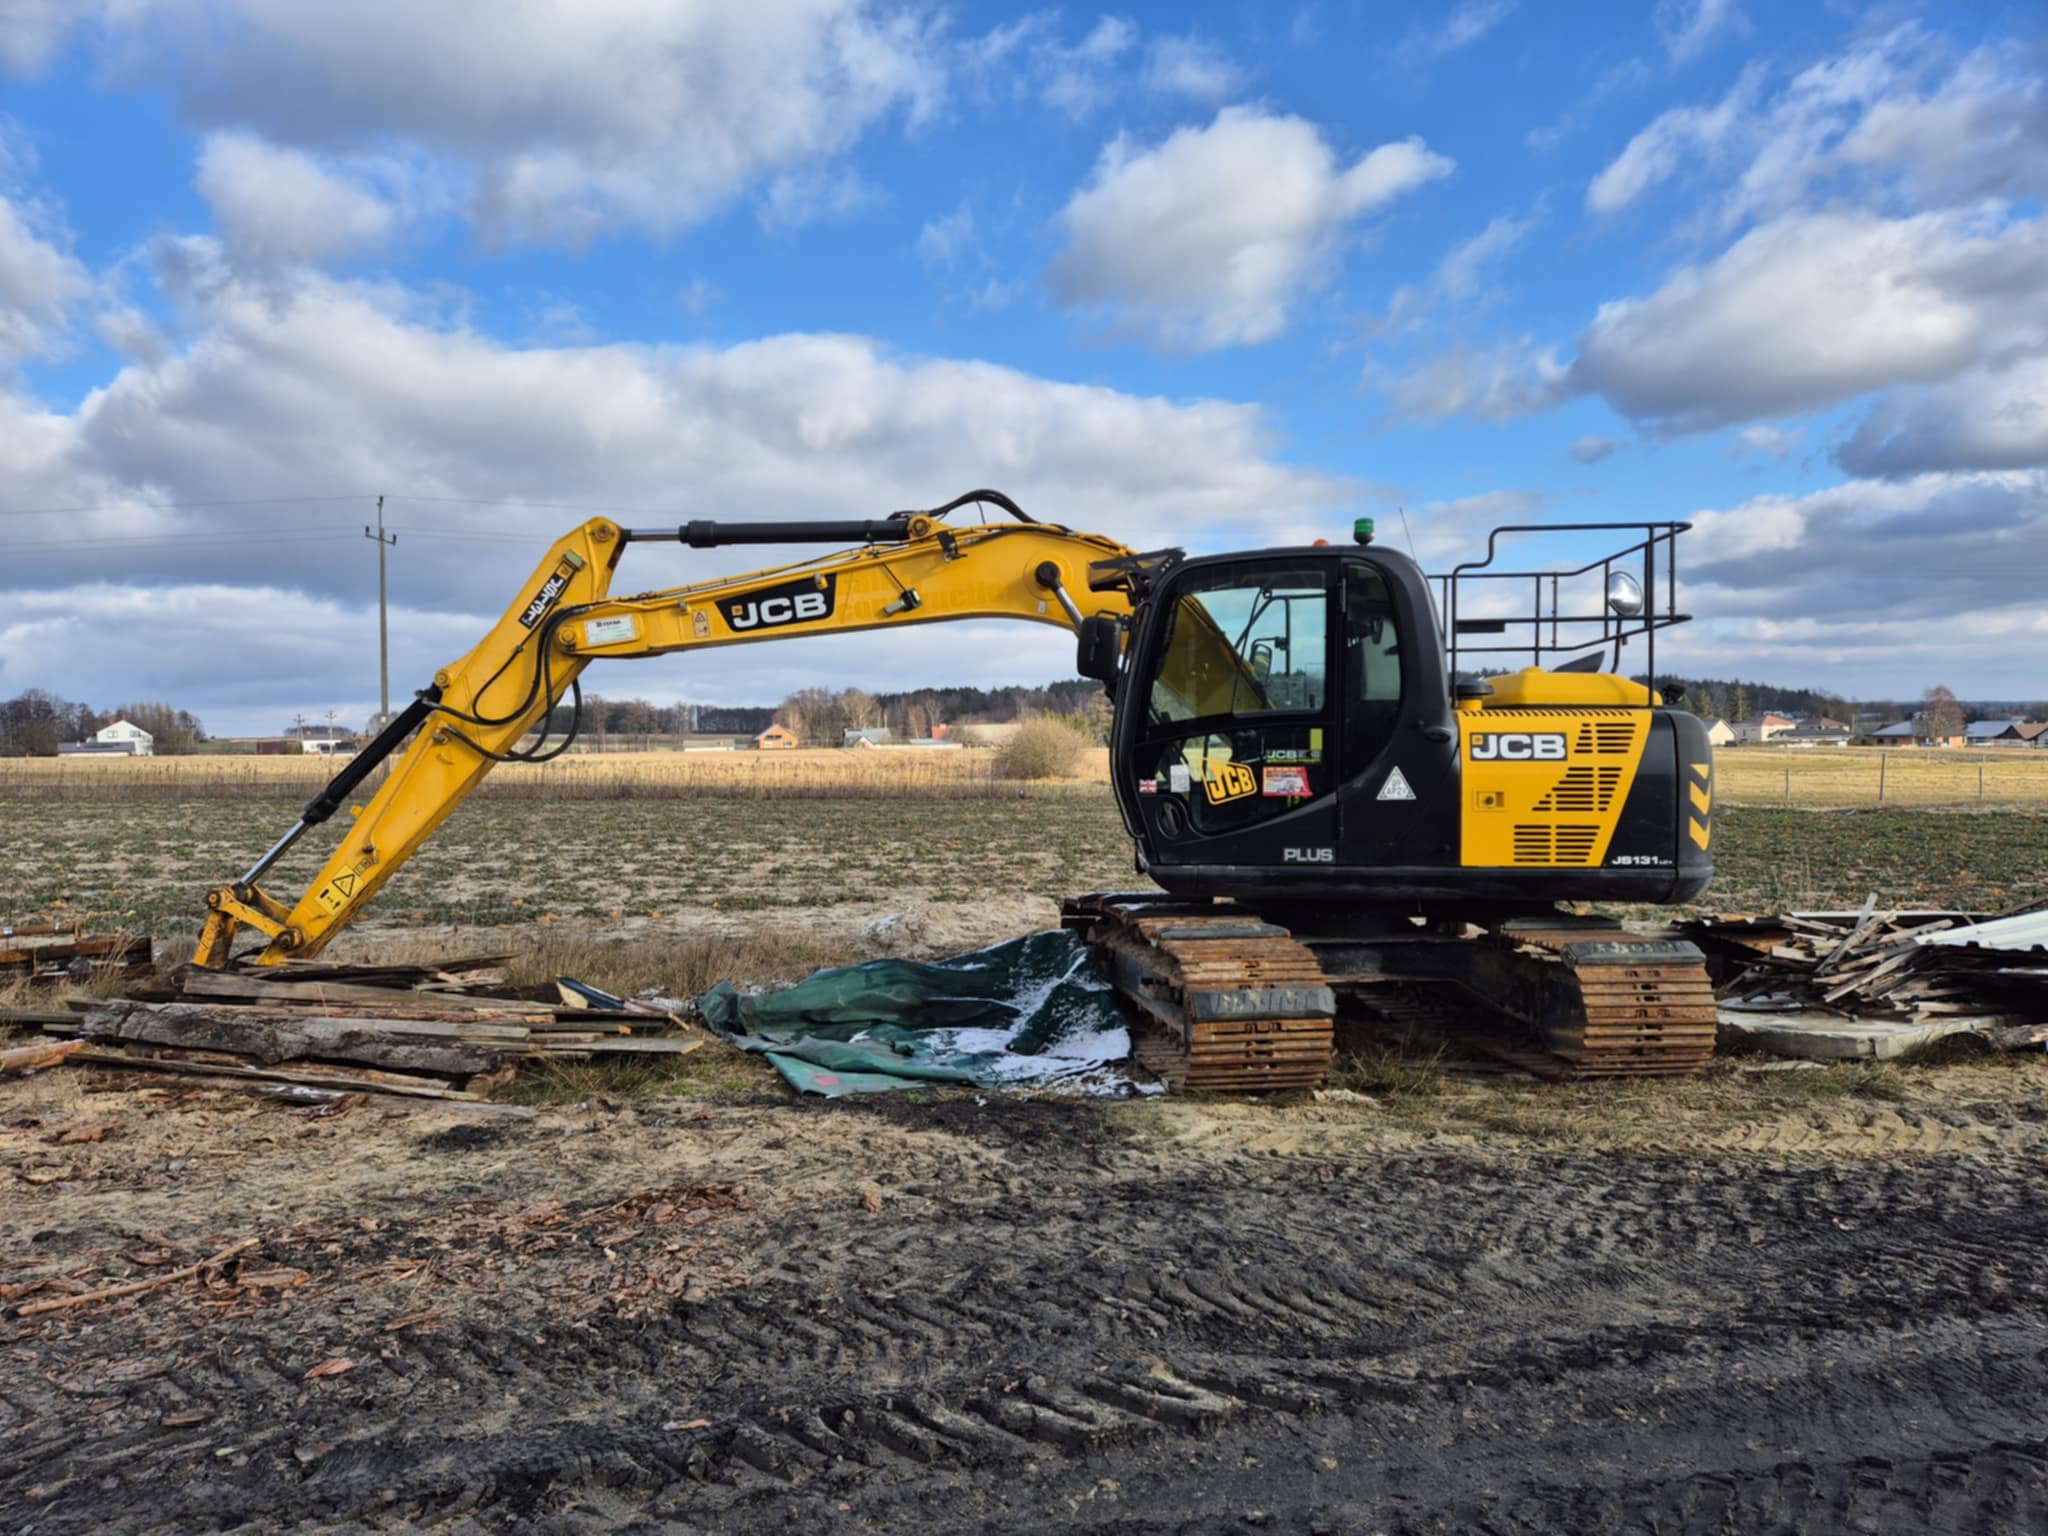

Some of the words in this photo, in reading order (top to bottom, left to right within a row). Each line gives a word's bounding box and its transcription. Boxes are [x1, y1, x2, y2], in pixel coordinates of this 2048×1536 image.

[733, 592, 827, 628] JCB
[1471, 733, 1567, 760] JCB
[1208, 763, 1253, 800] JCB
[1284, 848, 1333, 862] PLUS
[1611, 855, 1658, 866] JS131
